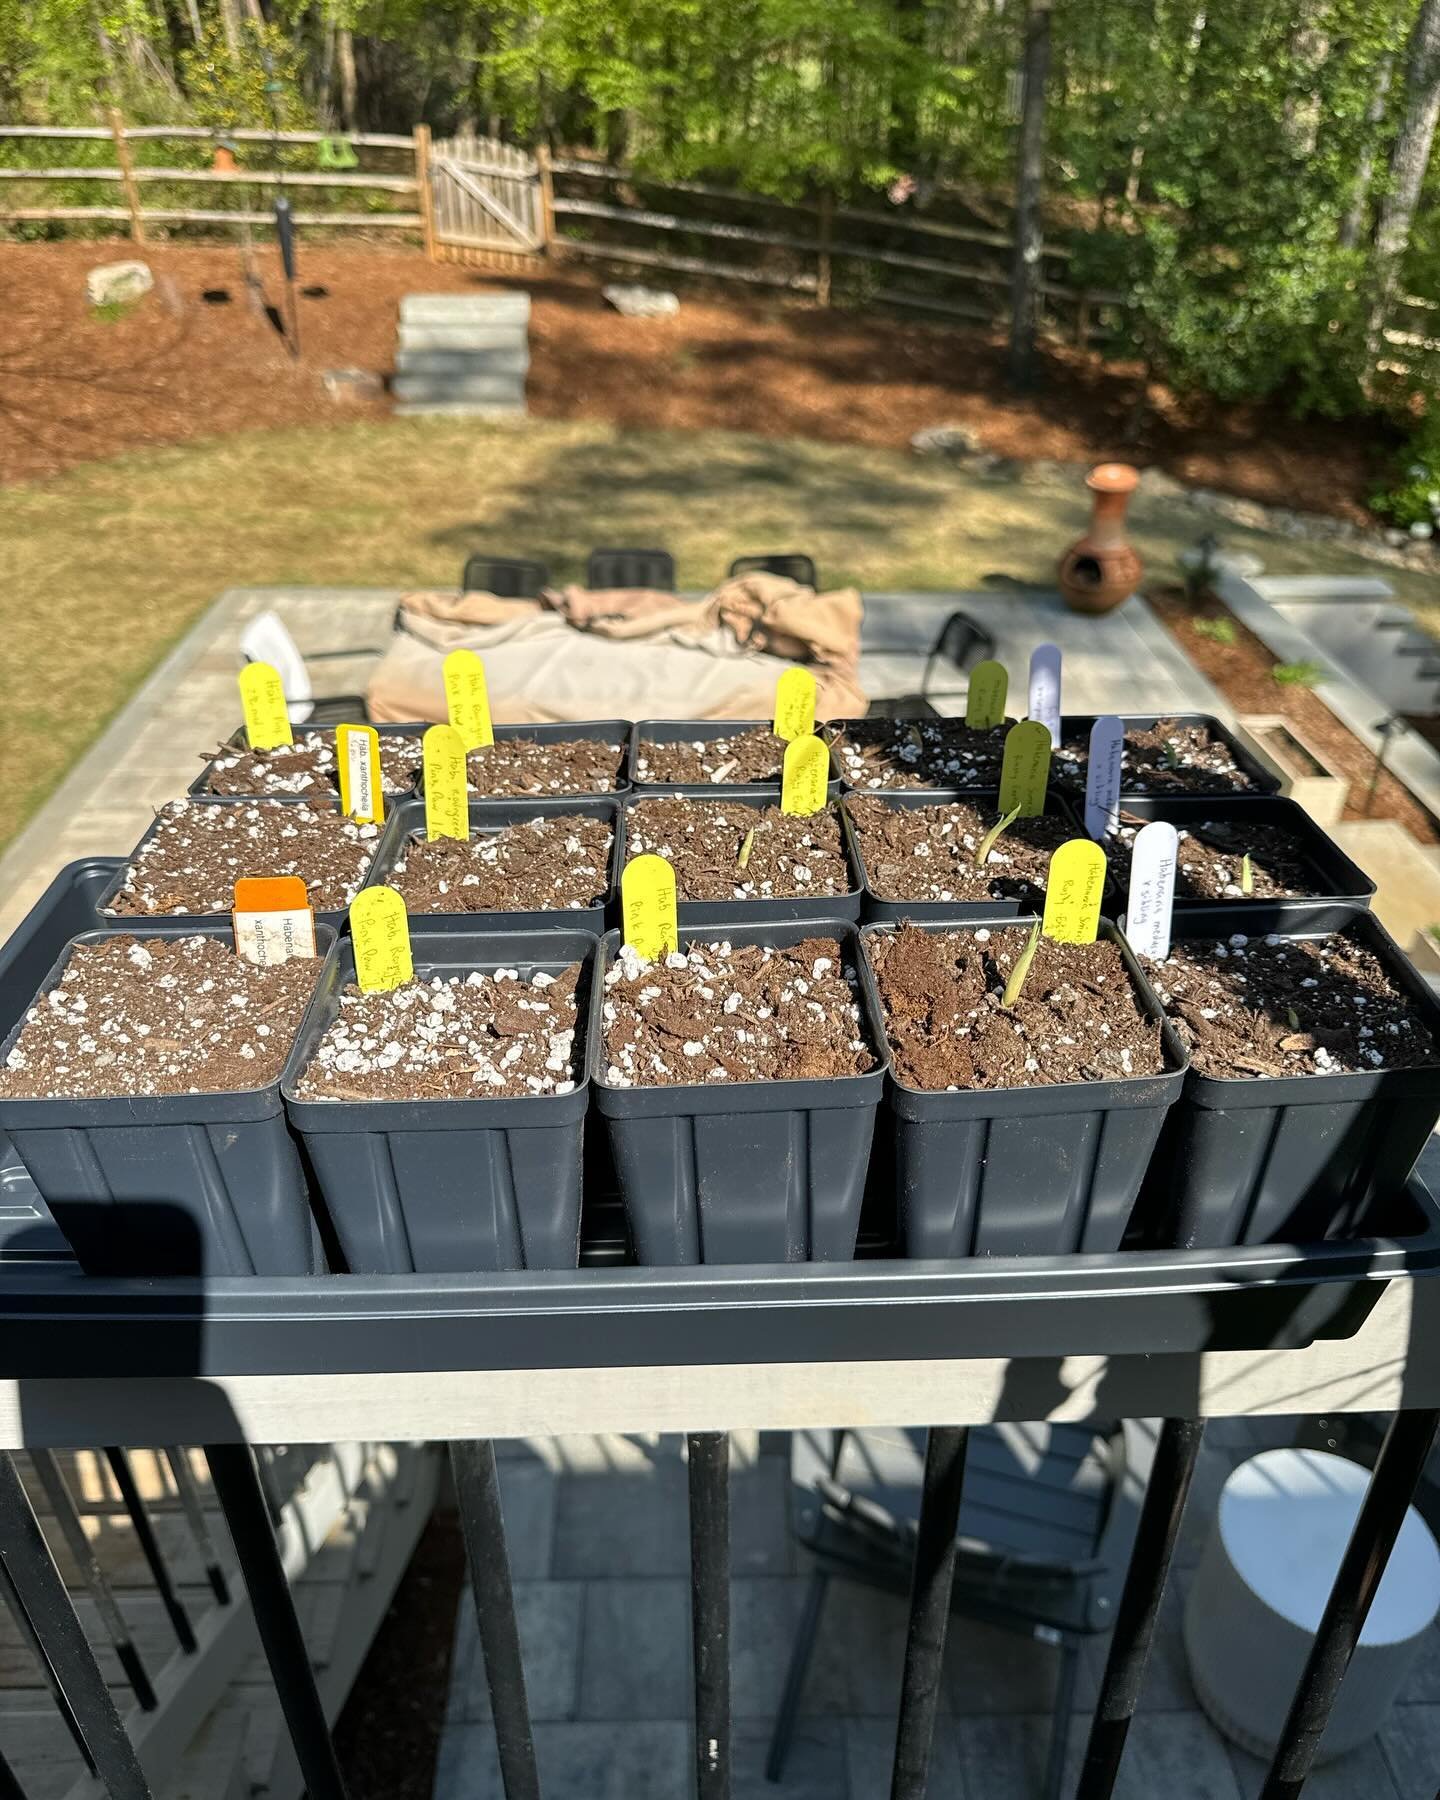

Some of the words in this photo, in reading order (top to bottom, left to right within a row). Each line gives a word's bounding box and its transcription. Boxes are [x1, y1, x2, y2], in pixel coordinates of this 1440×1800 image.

[359, 739, 369, 759] Hab.
[359, 760, 369, 812] xanthocheila
[1153, 858, 1173, 914] Habenaria
[630, 900, 643, 930] Pink
[1133, 890, 1152, 925] sibling
[255, 919, 268, 966] xanthoche
[358, 918, 376, 946] Pink
